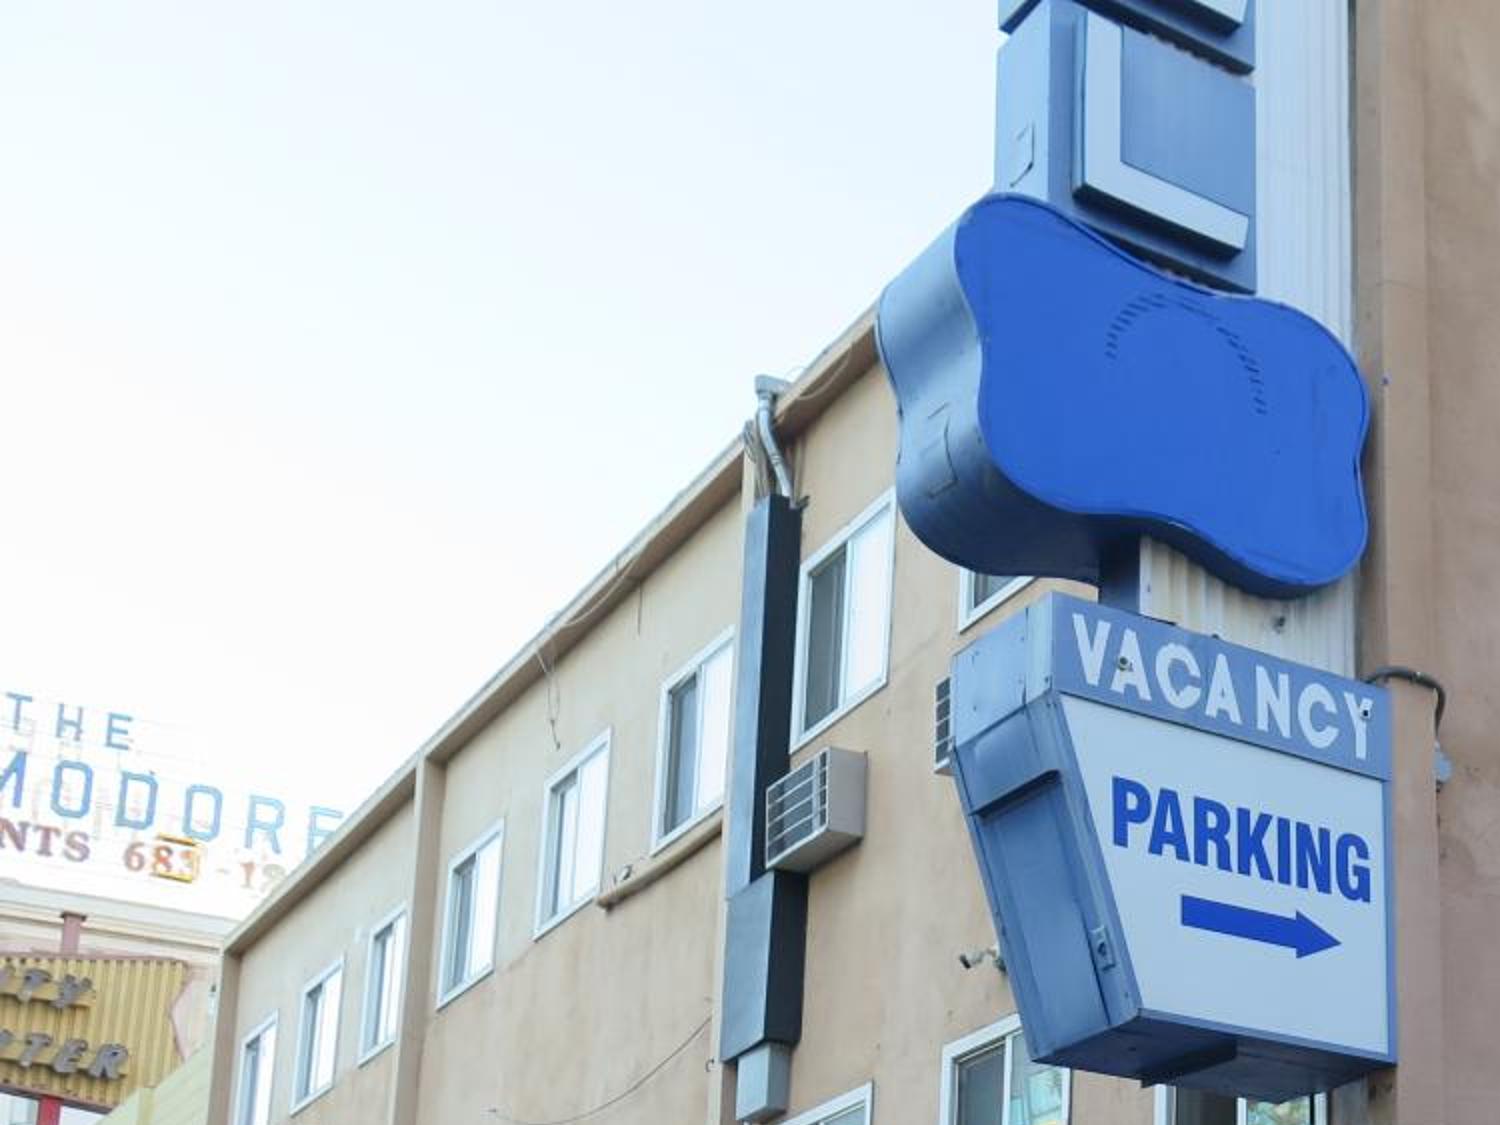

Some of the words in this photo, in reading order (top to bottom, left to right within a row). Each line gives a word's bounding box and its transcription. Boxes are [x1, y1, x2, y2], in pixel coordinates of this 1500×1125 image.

[6, 691, 135, 751] THE
[1072, 612, 1374, 760] VACANCY
[1111, 775, 1371, 904] PARKING
